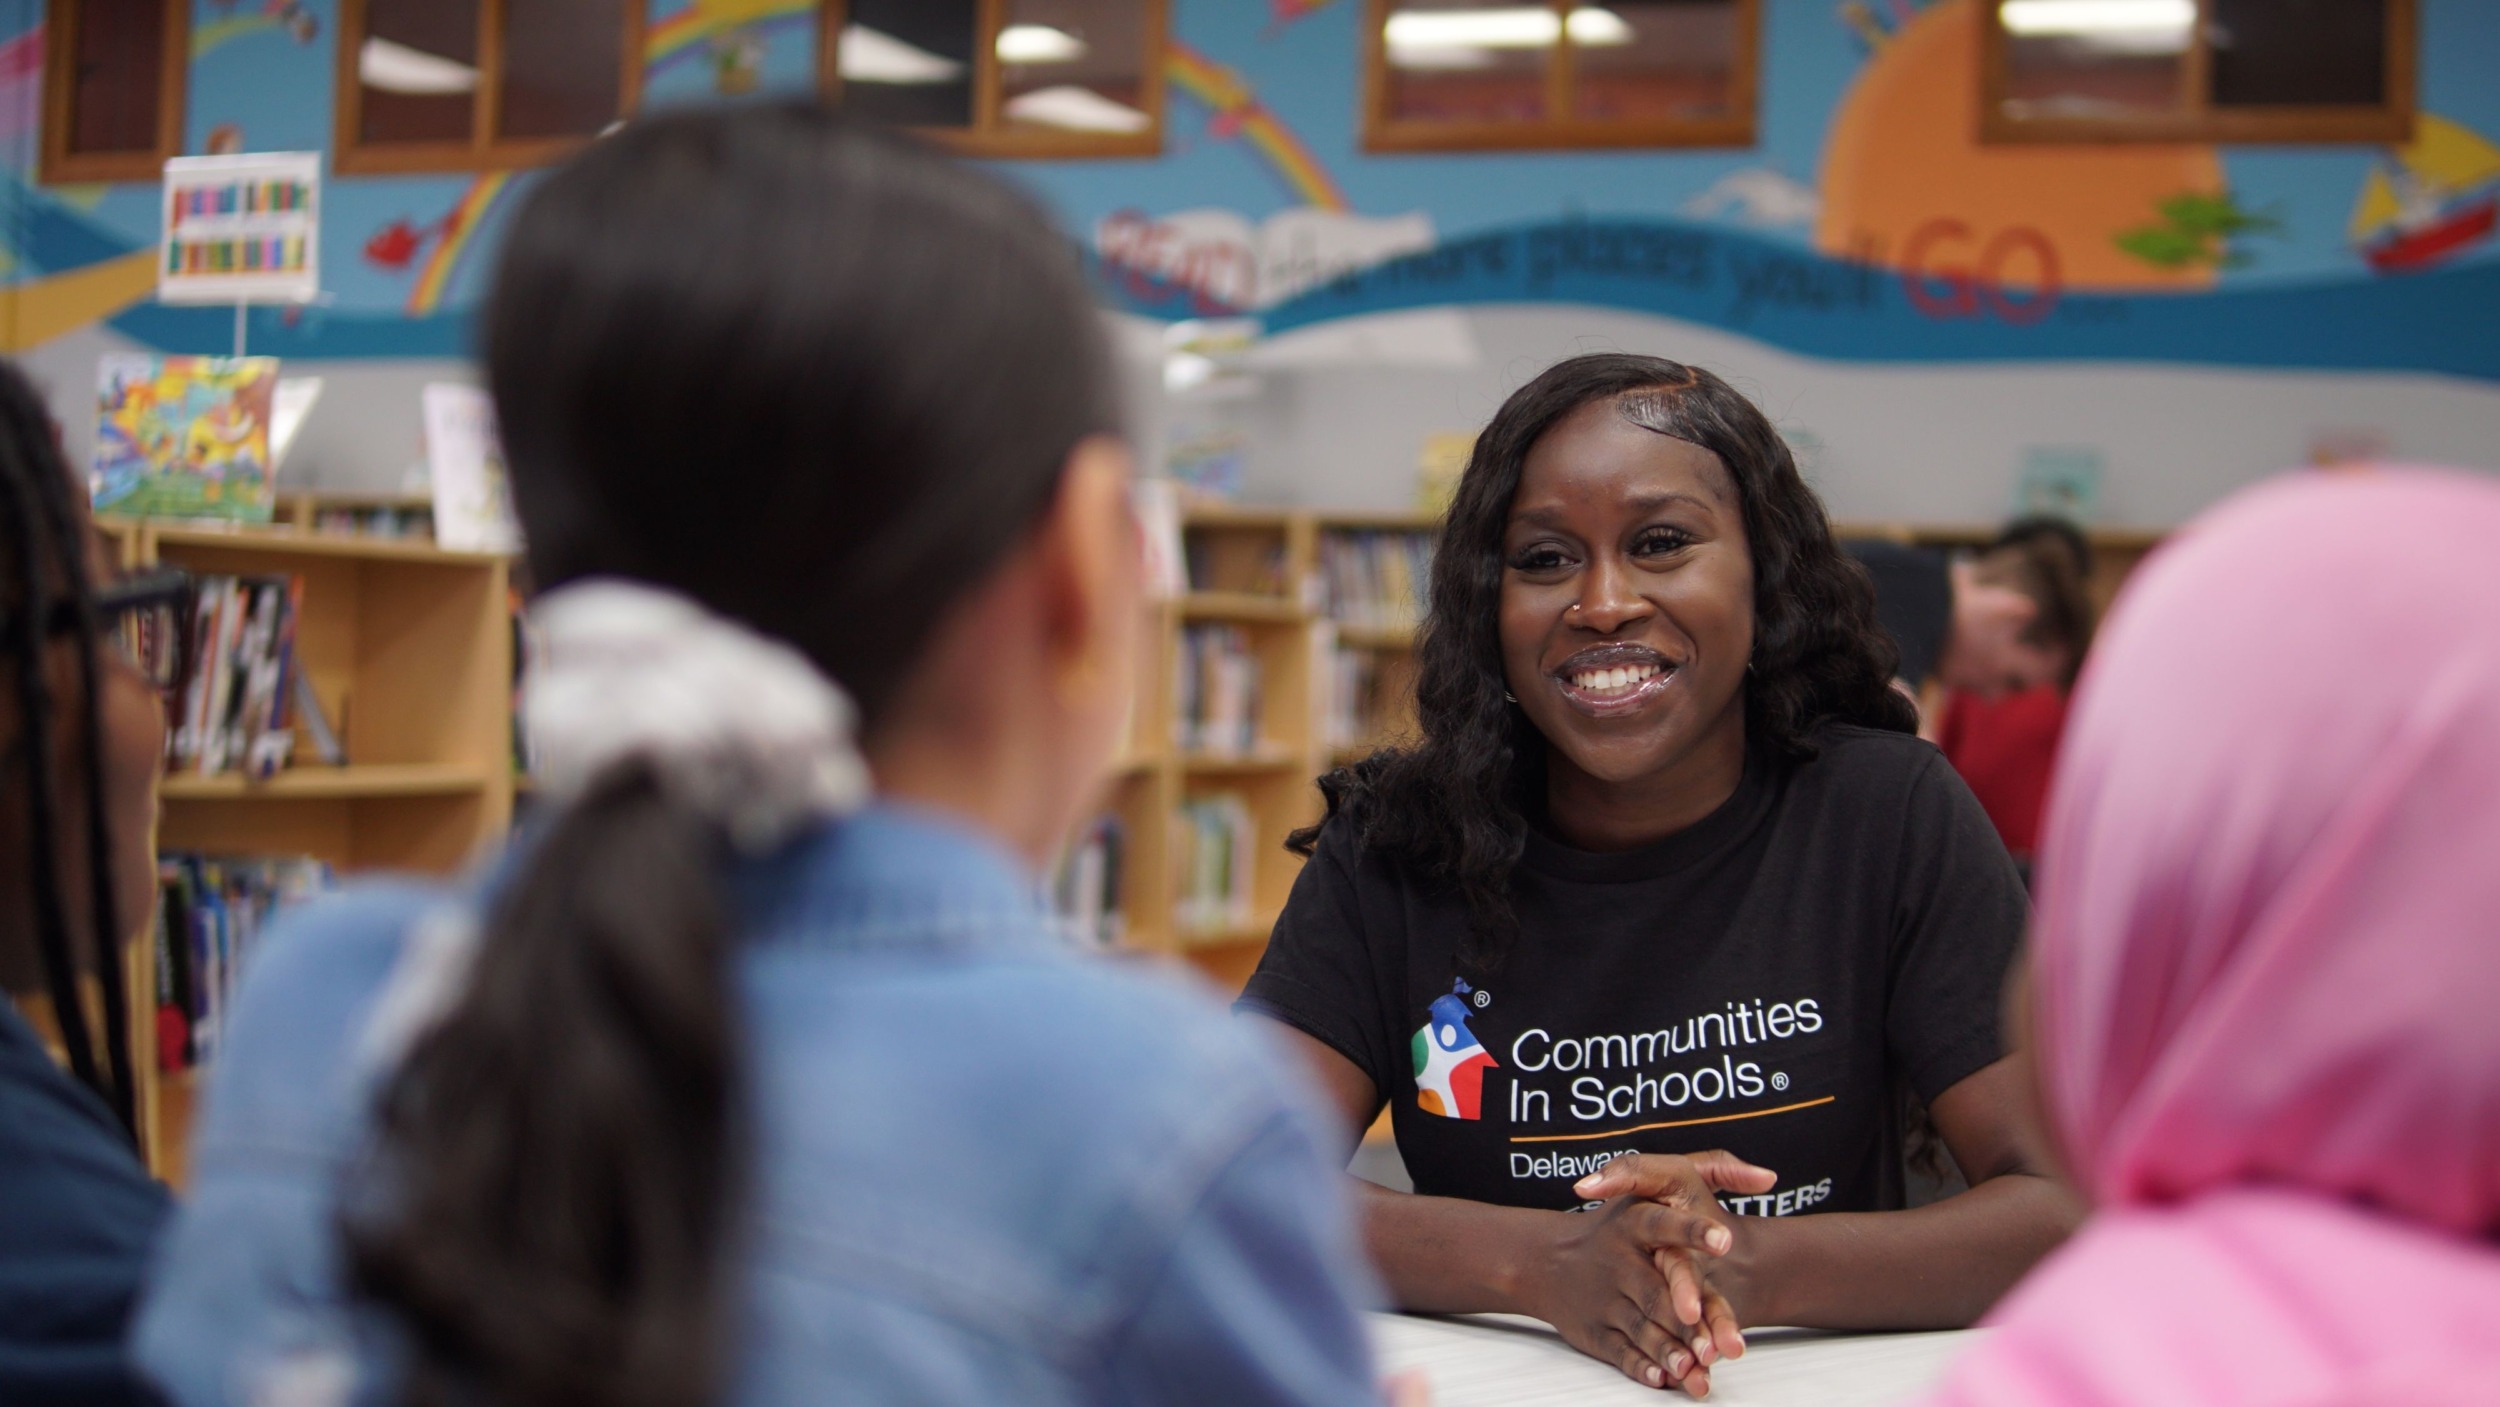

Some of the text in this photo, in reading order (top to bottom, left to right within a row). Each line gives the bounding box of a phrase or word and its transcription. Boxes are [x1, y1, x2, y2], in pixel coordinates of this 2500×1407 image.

[1512, 998, 1823, 1072] Communities
[1510, 1078, 1550, 1122] In
[1510, 1148, 1641, 1179] Delawar
[1717, 1177, 1832, 1218] TTERS
